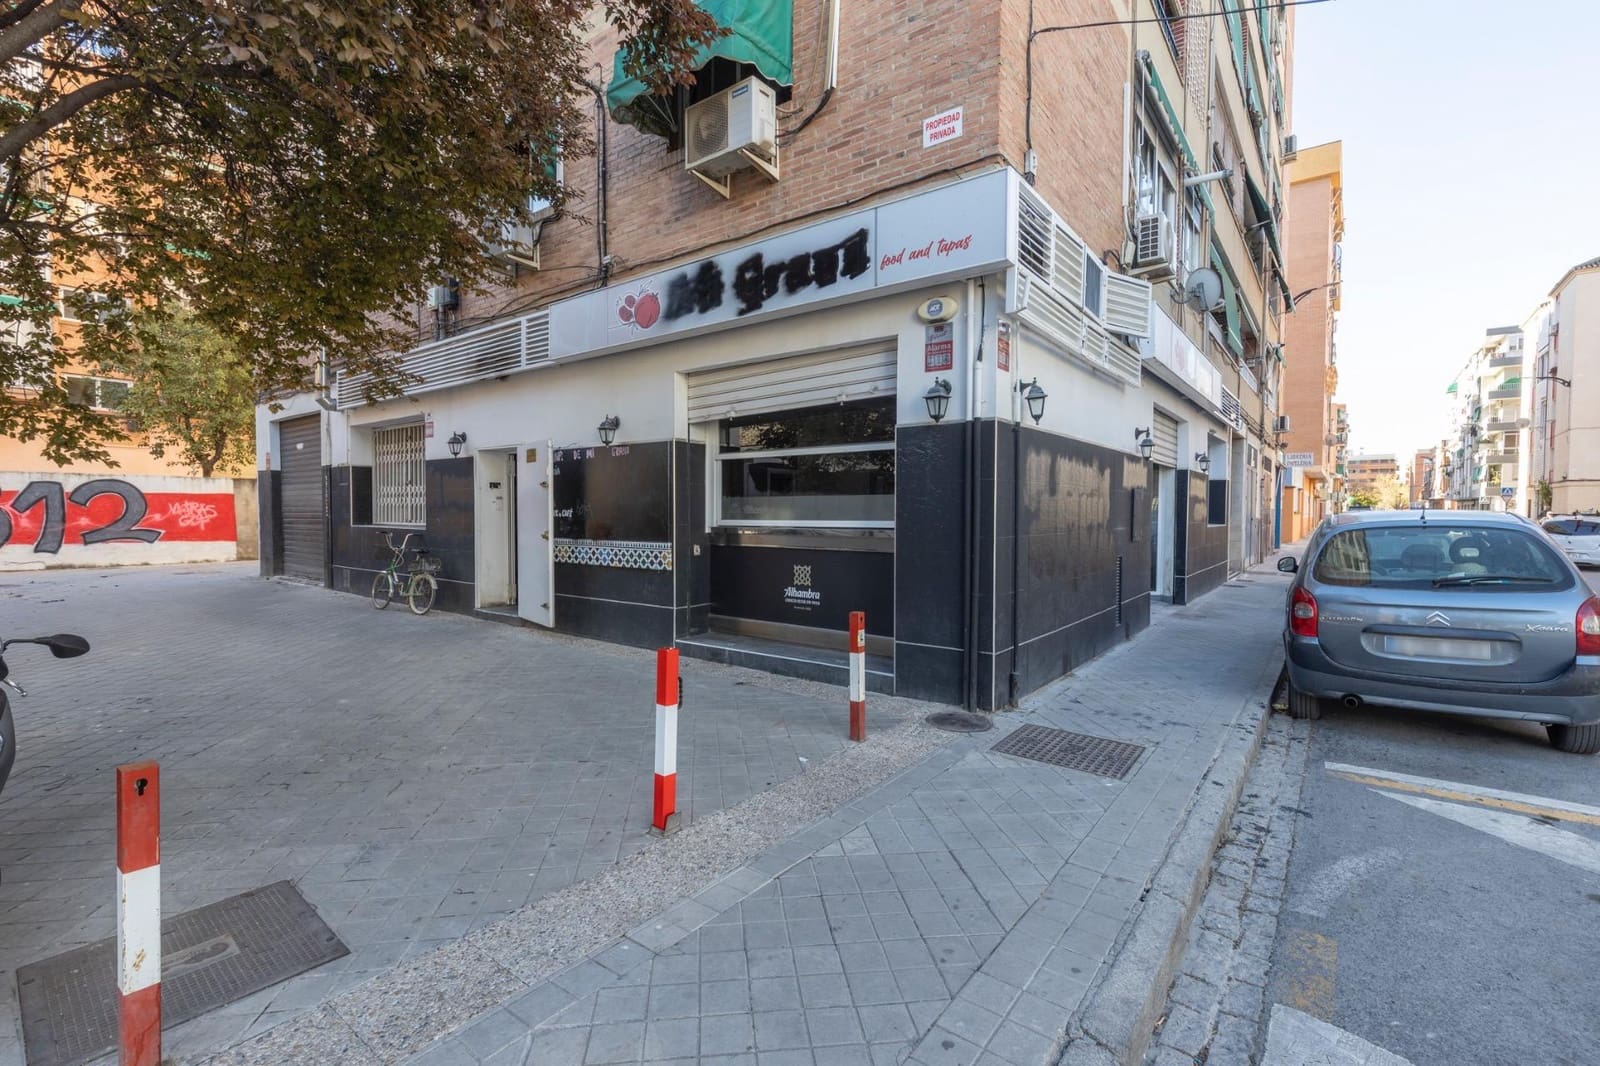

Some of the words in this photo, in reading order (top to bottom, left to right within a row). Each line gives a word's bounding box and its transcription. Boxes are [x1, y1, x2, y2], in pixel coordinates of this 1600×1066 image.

[925, 111, 961, 131] PROPIEDAD
[930, 125, 956, 142] PRIVADA
[880, 247, 906, 270] food
[908, 241, 934, 260] and
[936, 234, 972, 256] tapas
[927, 342, 951, 352] Alarma
[0, 479, 163, 554] 12
[783, 586, 821, 600] Alhambra
